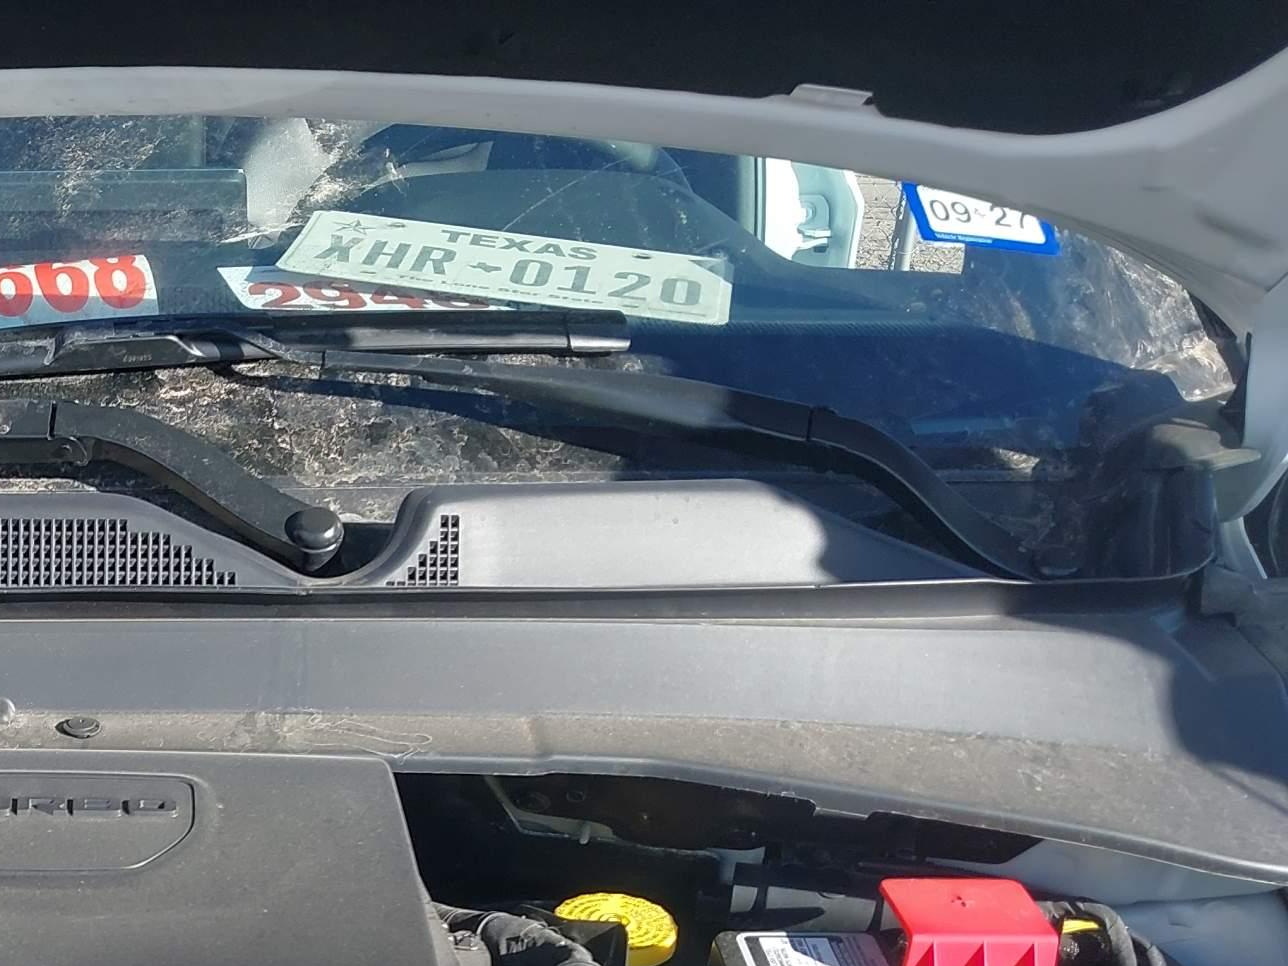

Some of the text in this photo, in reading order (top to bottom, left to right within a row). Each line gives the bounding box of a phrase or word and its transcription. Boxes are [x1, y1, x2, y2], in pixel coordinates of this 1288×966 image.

[928, 199, 971, 223] 09
[439, 229, 599, 261] TEXAS
[313, 234, 704, 307] XHR 0120
